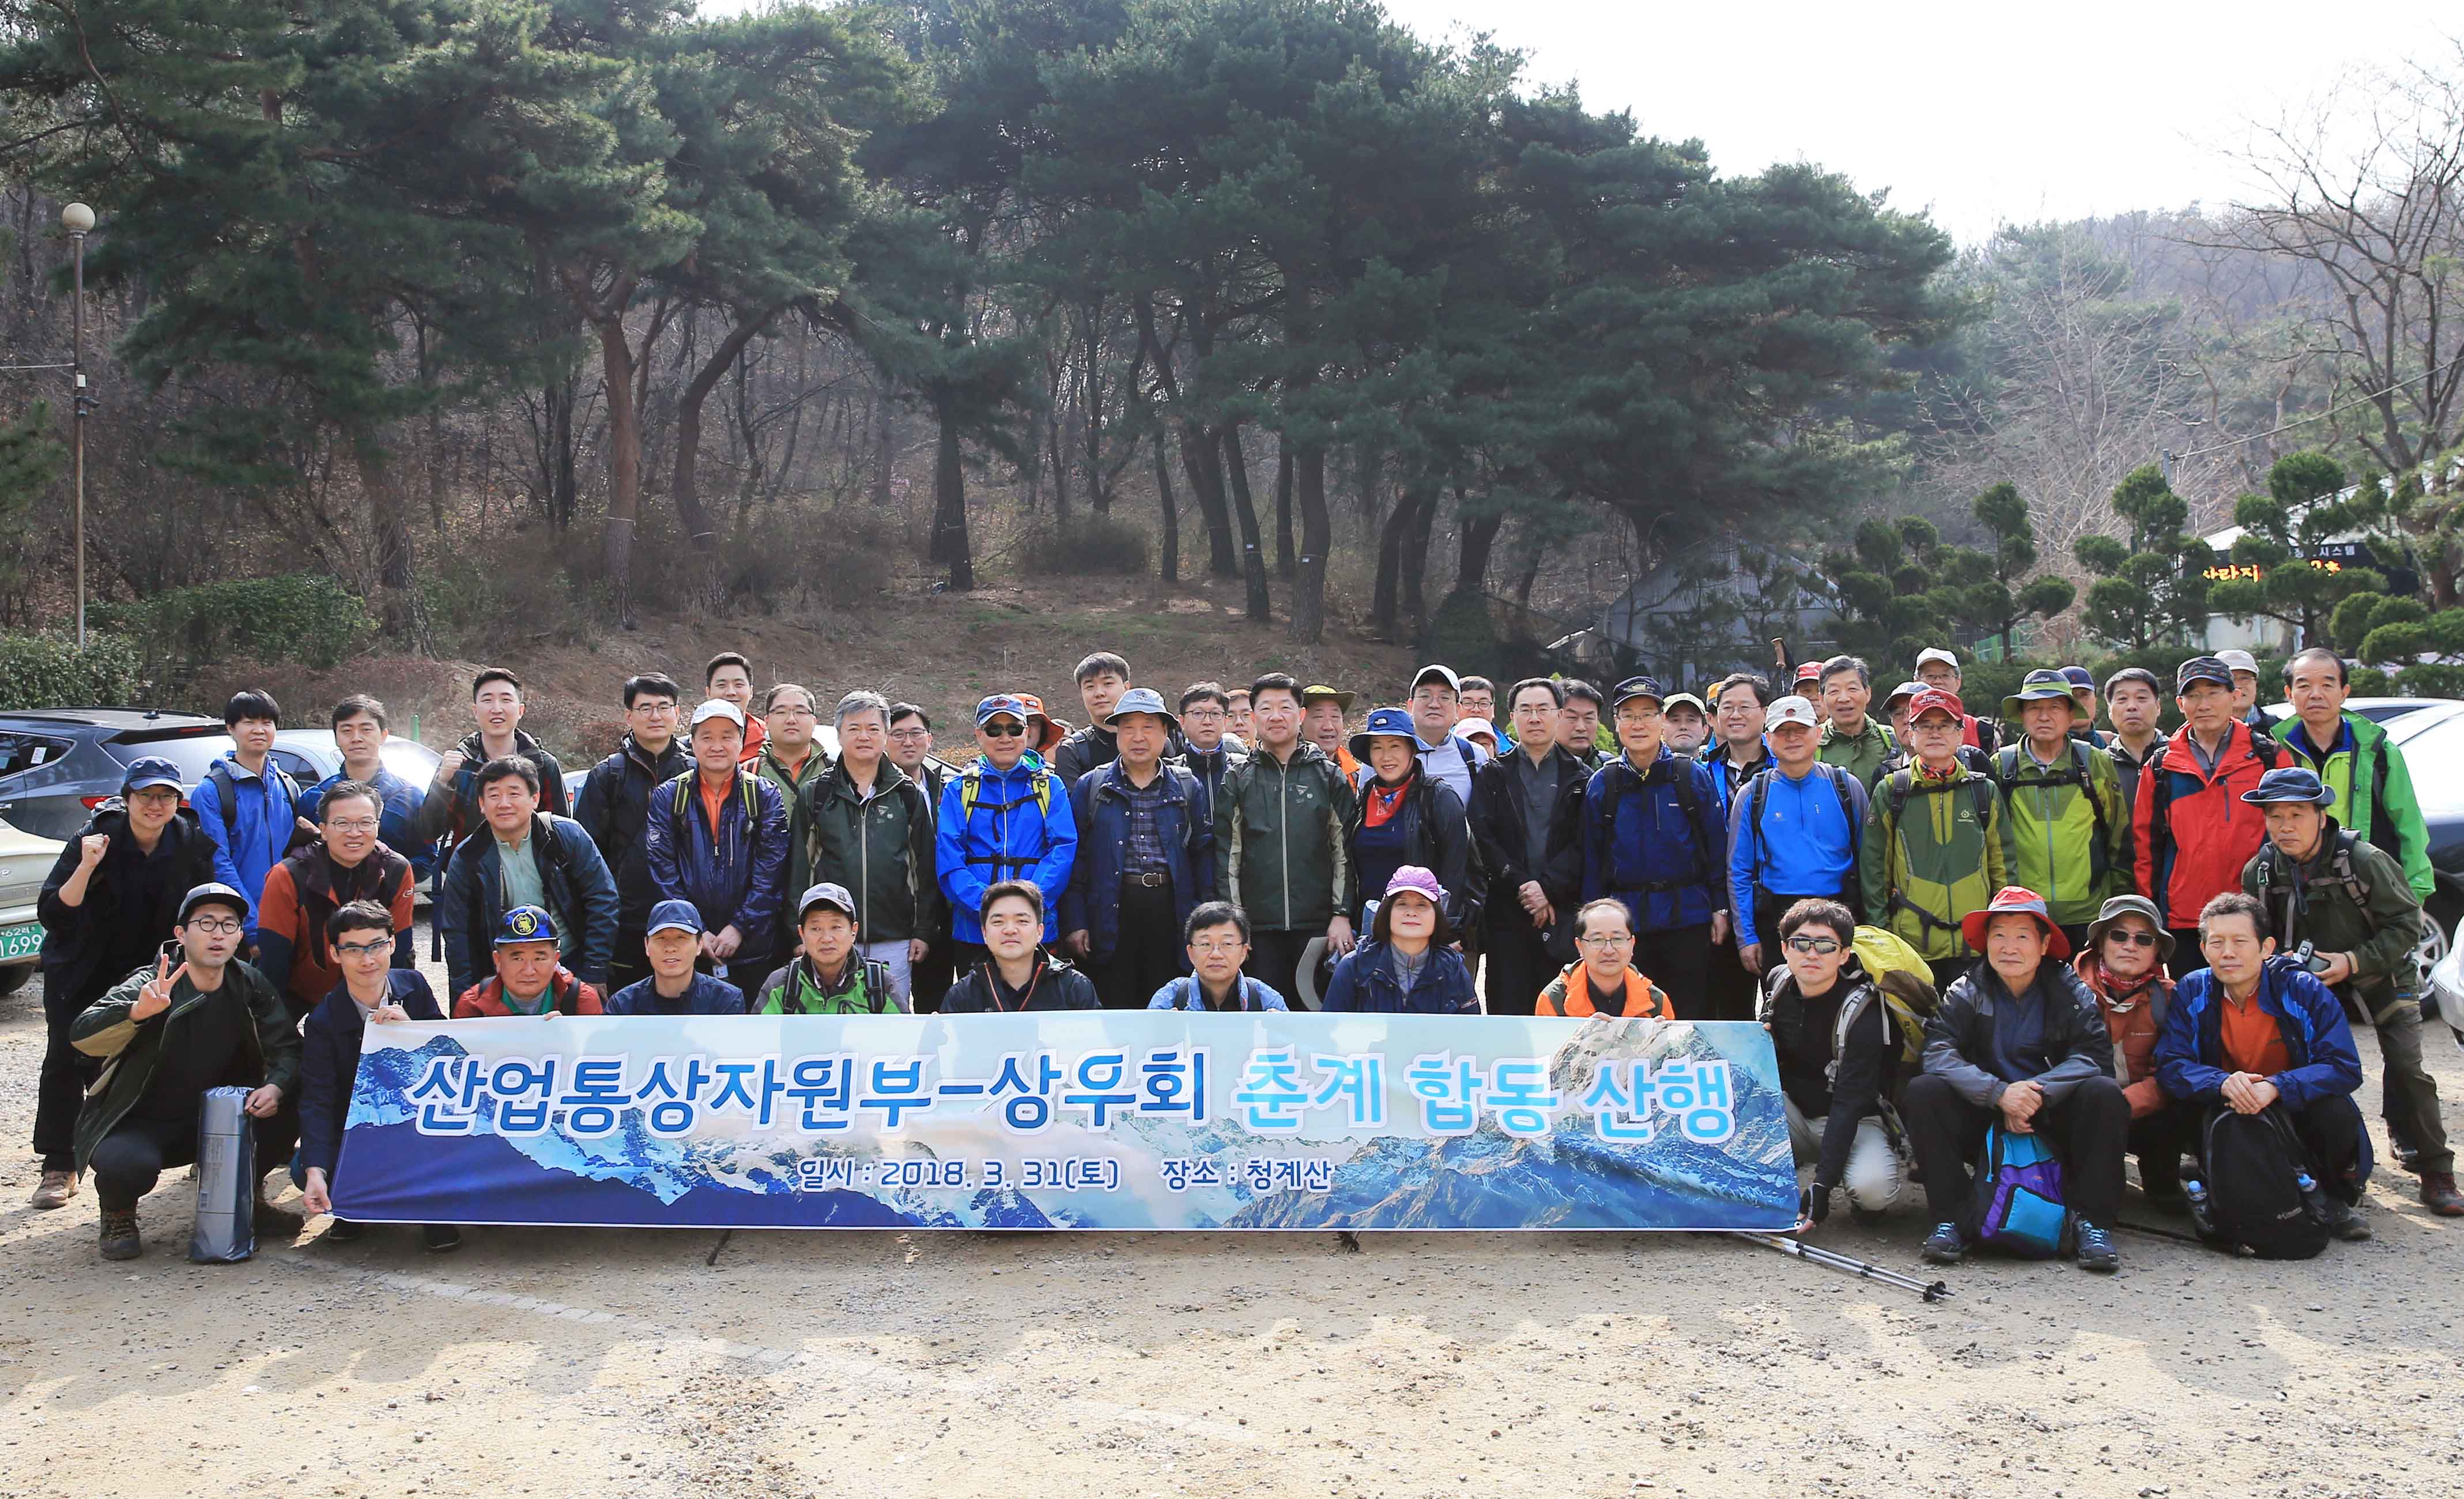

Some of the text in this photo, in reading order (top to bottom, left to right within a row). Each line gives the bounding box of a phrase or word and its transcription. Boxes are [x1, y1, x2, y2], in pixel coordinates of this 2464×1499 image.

[1236, 1053, 1382, 1128] 춘계
[1408, 1059, 1559, 1133] 합동
[1585, 1063, 1731, 1139] 산행
[799, 1160, 852, 1189] 일시
[880, 1160, 973, 1189] 2018.
[982, 1160, 1013, 1189] 3.
[1022, 1158, 1119, 1189] 31(토)
[1161, 1160, 1220, 1191] 장소
[1246, 1159, 1333, 1191] 청계산
